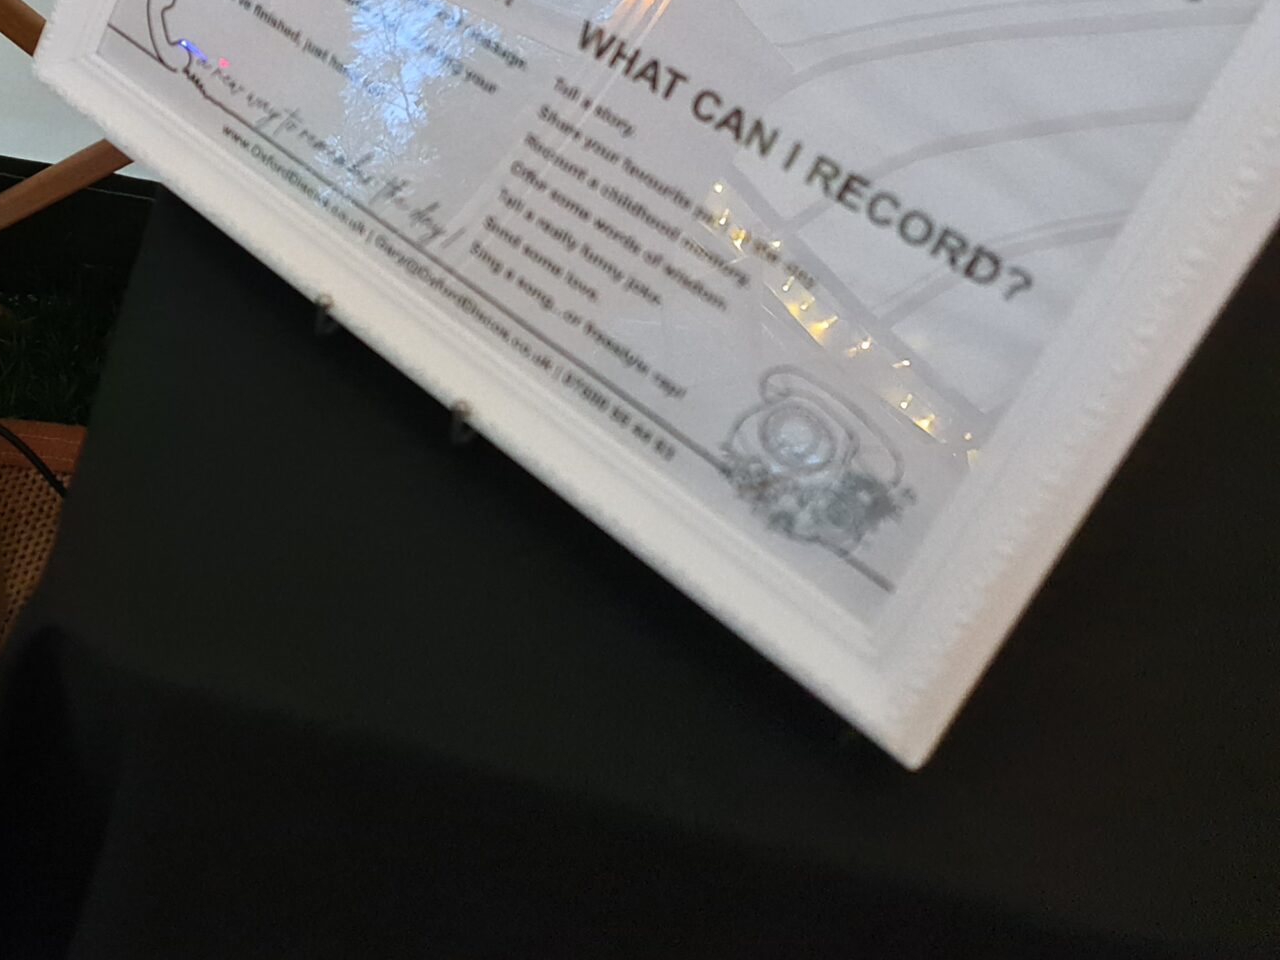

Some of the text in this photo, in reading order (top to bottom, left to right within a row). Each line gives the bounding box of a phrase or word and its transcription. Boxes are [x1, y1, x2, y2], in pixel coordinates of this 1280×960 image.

[579, 20, 1032, 300] WHAT CAN I RECORD?
